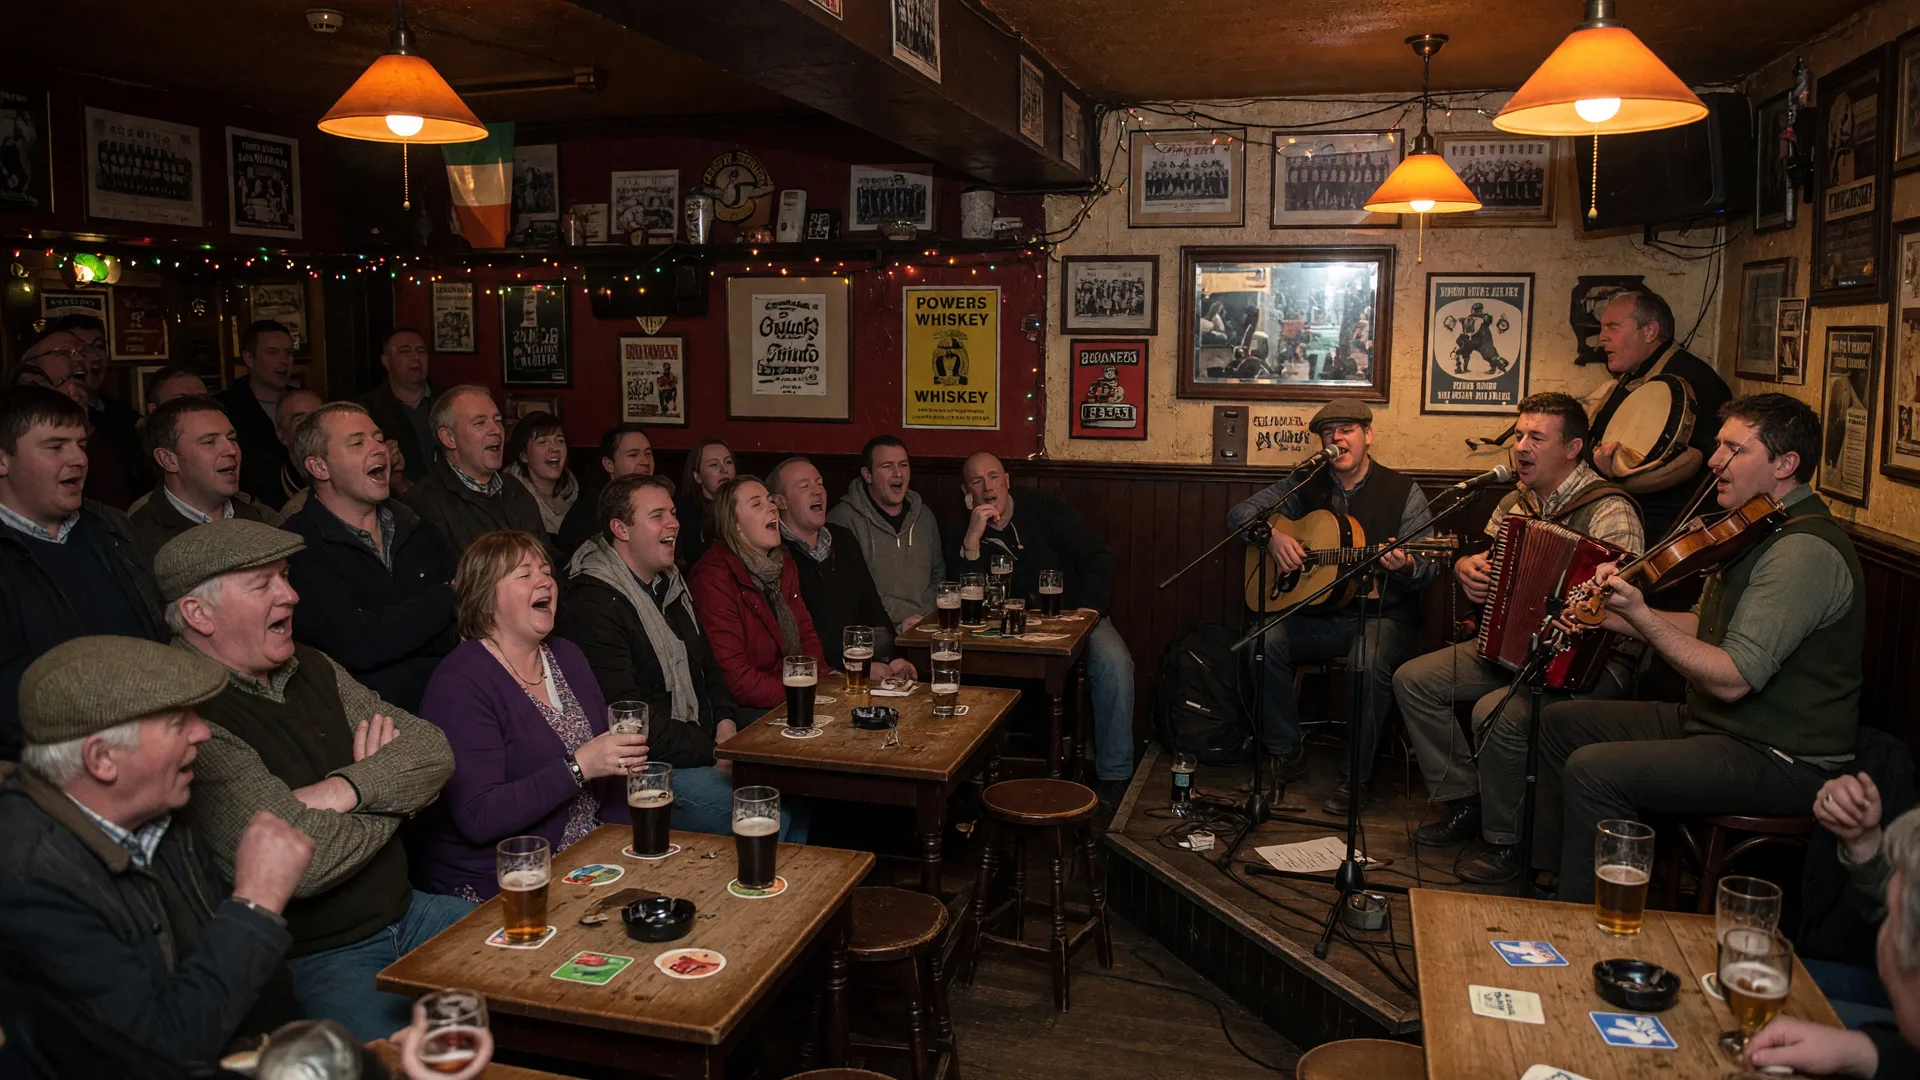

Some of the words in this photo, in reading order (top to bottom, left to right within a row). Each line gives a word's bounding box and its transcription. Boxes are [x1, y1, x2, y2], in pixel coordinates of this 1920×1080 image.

[916, 296, 987, 310] POWERS
[915, 313, 989, 326] WHISKEY
[914, 390, 989, 404] WHISKEY
